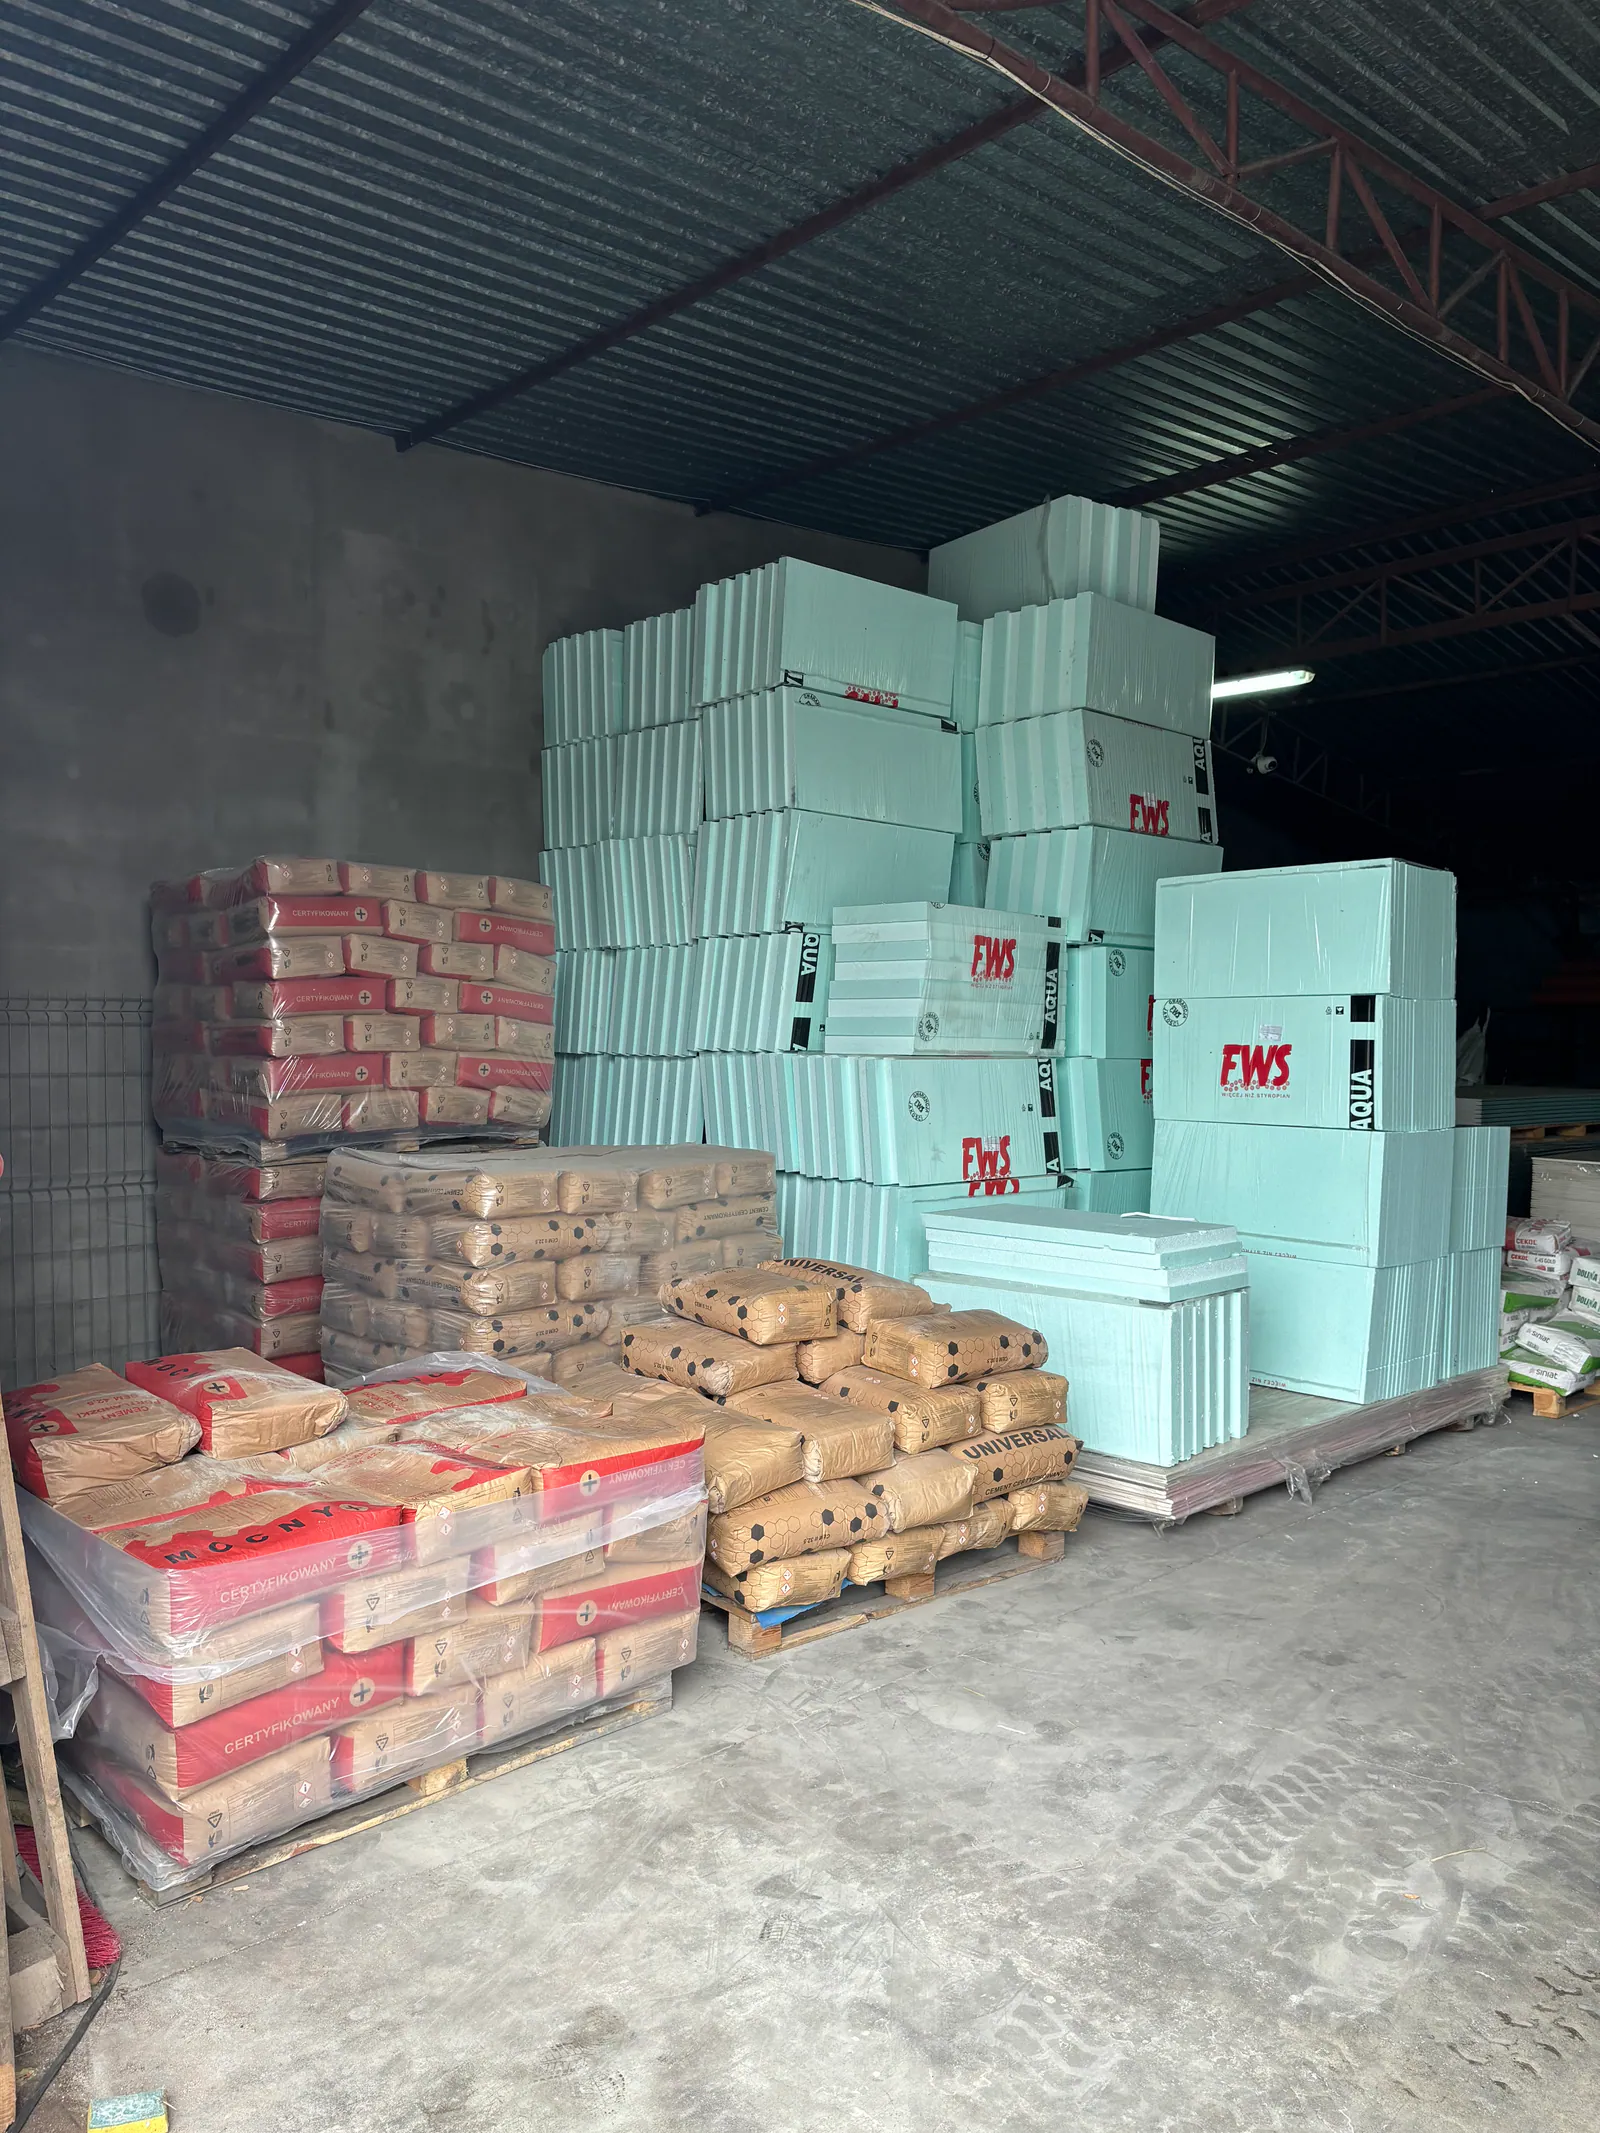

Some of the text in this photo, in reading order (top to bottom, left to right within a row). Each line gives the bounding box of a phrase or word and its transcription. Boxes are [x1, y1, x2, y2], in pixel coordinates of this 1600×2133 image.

[1129, 794, 1170, 836] FWS
[292, 909, 349, 917] CERTYFIKOWANY
[496, 925, 543, 937] CERTYFIKOWANY
[970, 934, 1017, 979] FWS
[296, 994, 354, 1003] CERTYFIKOWANY
[497, 997, 544, 1009] CERTYFIKOWANY
[1044, 968, 1058, 1024] AQUA
[495, 1067, 542, 1077] CERTYFIKOWANY
[1220, 1044, 1292, 1087] FWS
[1350, 1069, 1373, 1130] AQUA
[962, 1135, 1011, 1181] FWS
[703, 1206, 769, 1221] CEMENT CERTYFIKOWANY
[1532, 1331, 1551, 1343] siniat
[1536, 1369, 1558, 1379] siniat
[101, 1406, 149, 1420] CEMENT
[962, 1428, 1070, 1459] UNIVERSAL
[608, 1459, 686, 1485] CERTYFIKOWANY
[985, 1483, 1012, 1496] CEMENT
[164, 1505, 334, 1565] MOCNY
[220, 1557, 337, 1604] CERTYFIKOWANY
[224, 1697, 340, 1755] CERTYFIKOWANY
